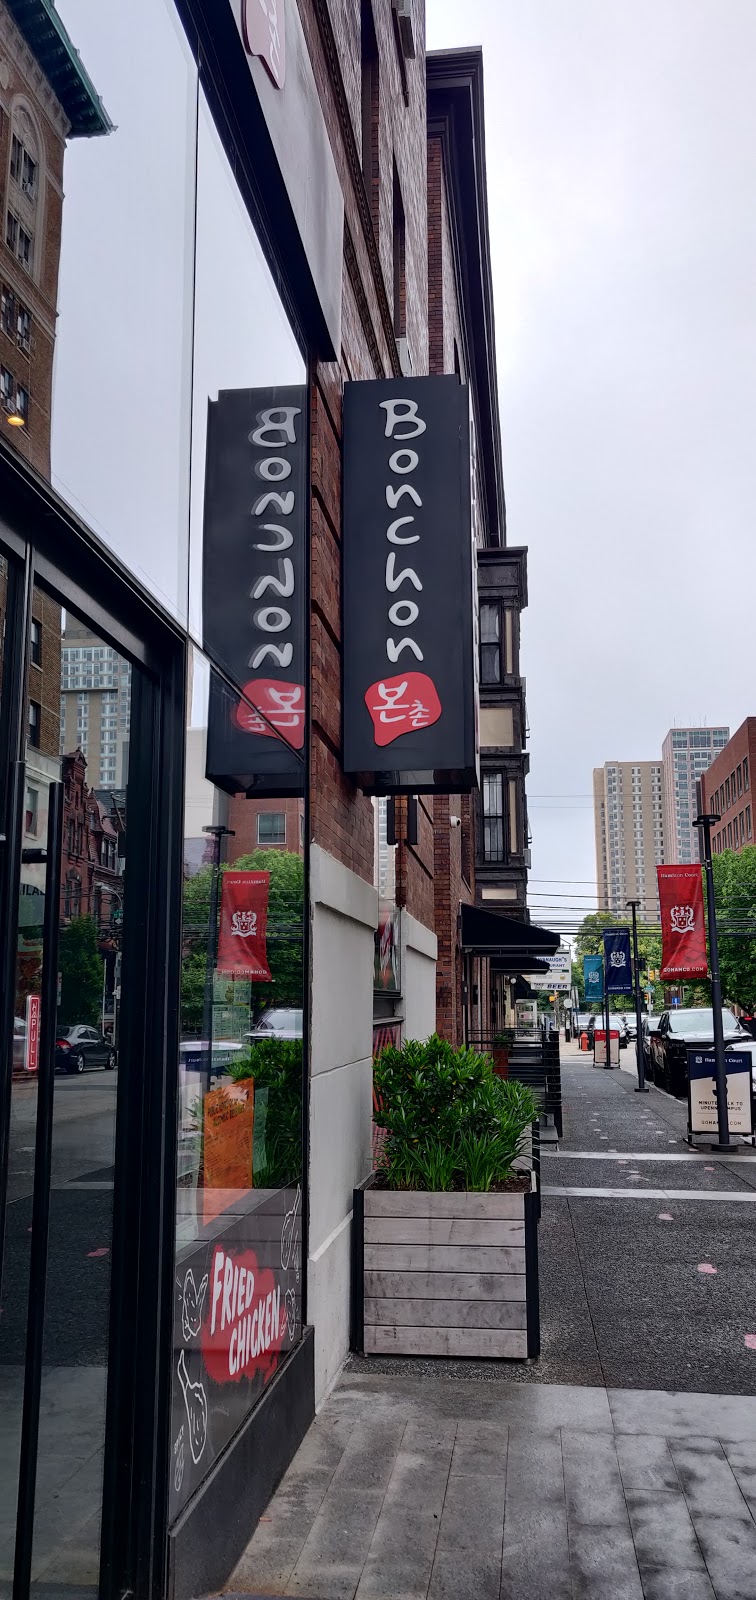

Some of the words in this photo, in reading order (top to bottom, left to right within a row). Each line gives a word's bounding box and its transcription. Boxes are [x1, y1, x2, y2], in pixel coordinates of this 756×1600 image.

[379, 398, 428, 664] Bonchon
[372, 680, 430, 727] 본촌
[210, 1251, 255, 1337] FRIED
[228, 1283, 281, 1376] CHICKEN
